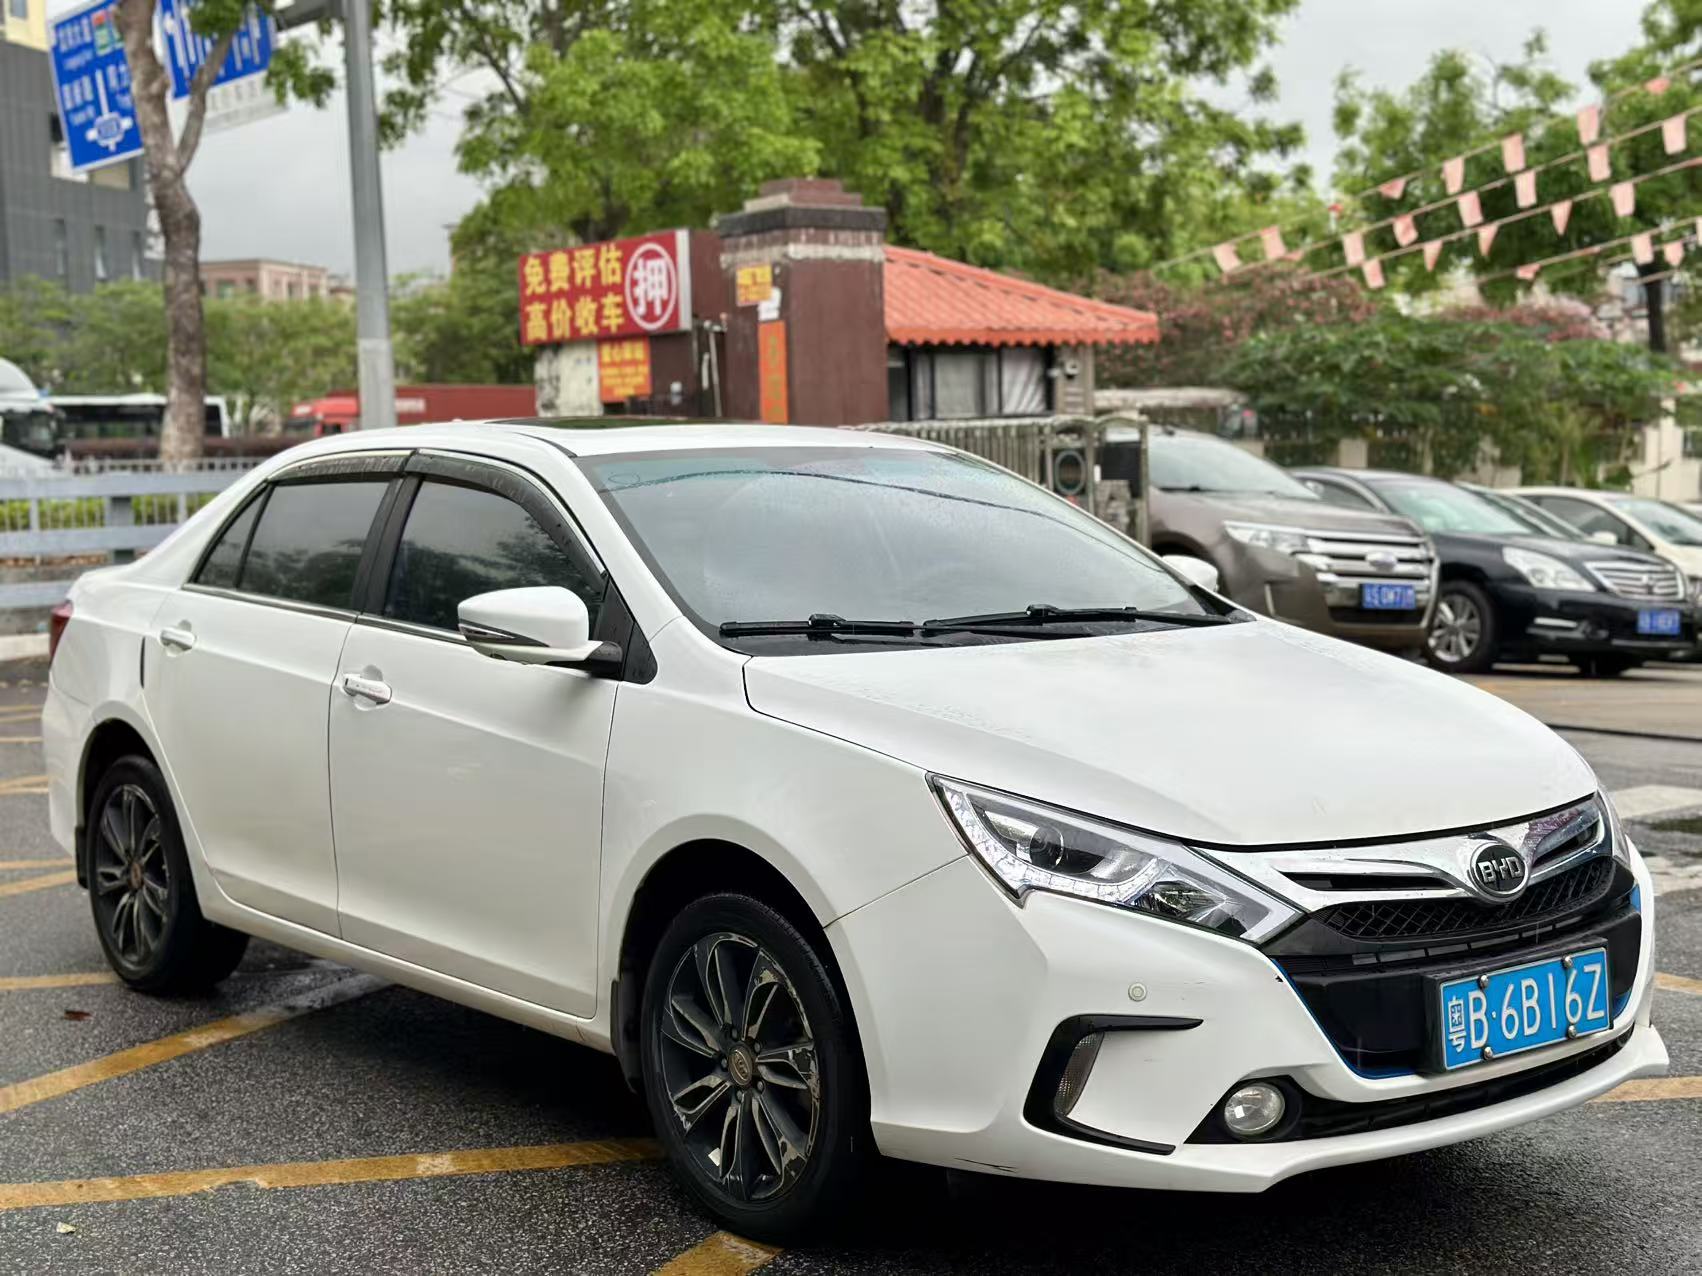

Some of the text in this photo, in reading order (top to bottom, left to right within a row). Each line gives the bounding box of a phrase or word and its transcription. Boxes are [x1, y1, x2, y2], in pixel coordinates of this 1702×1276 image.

[525, 243, 622, 295] 免费评估
[634, 258, 669, 316] 押
[526, 292, 624, 341] 高价收车
[1478, 857, 1523, 883] BYD
